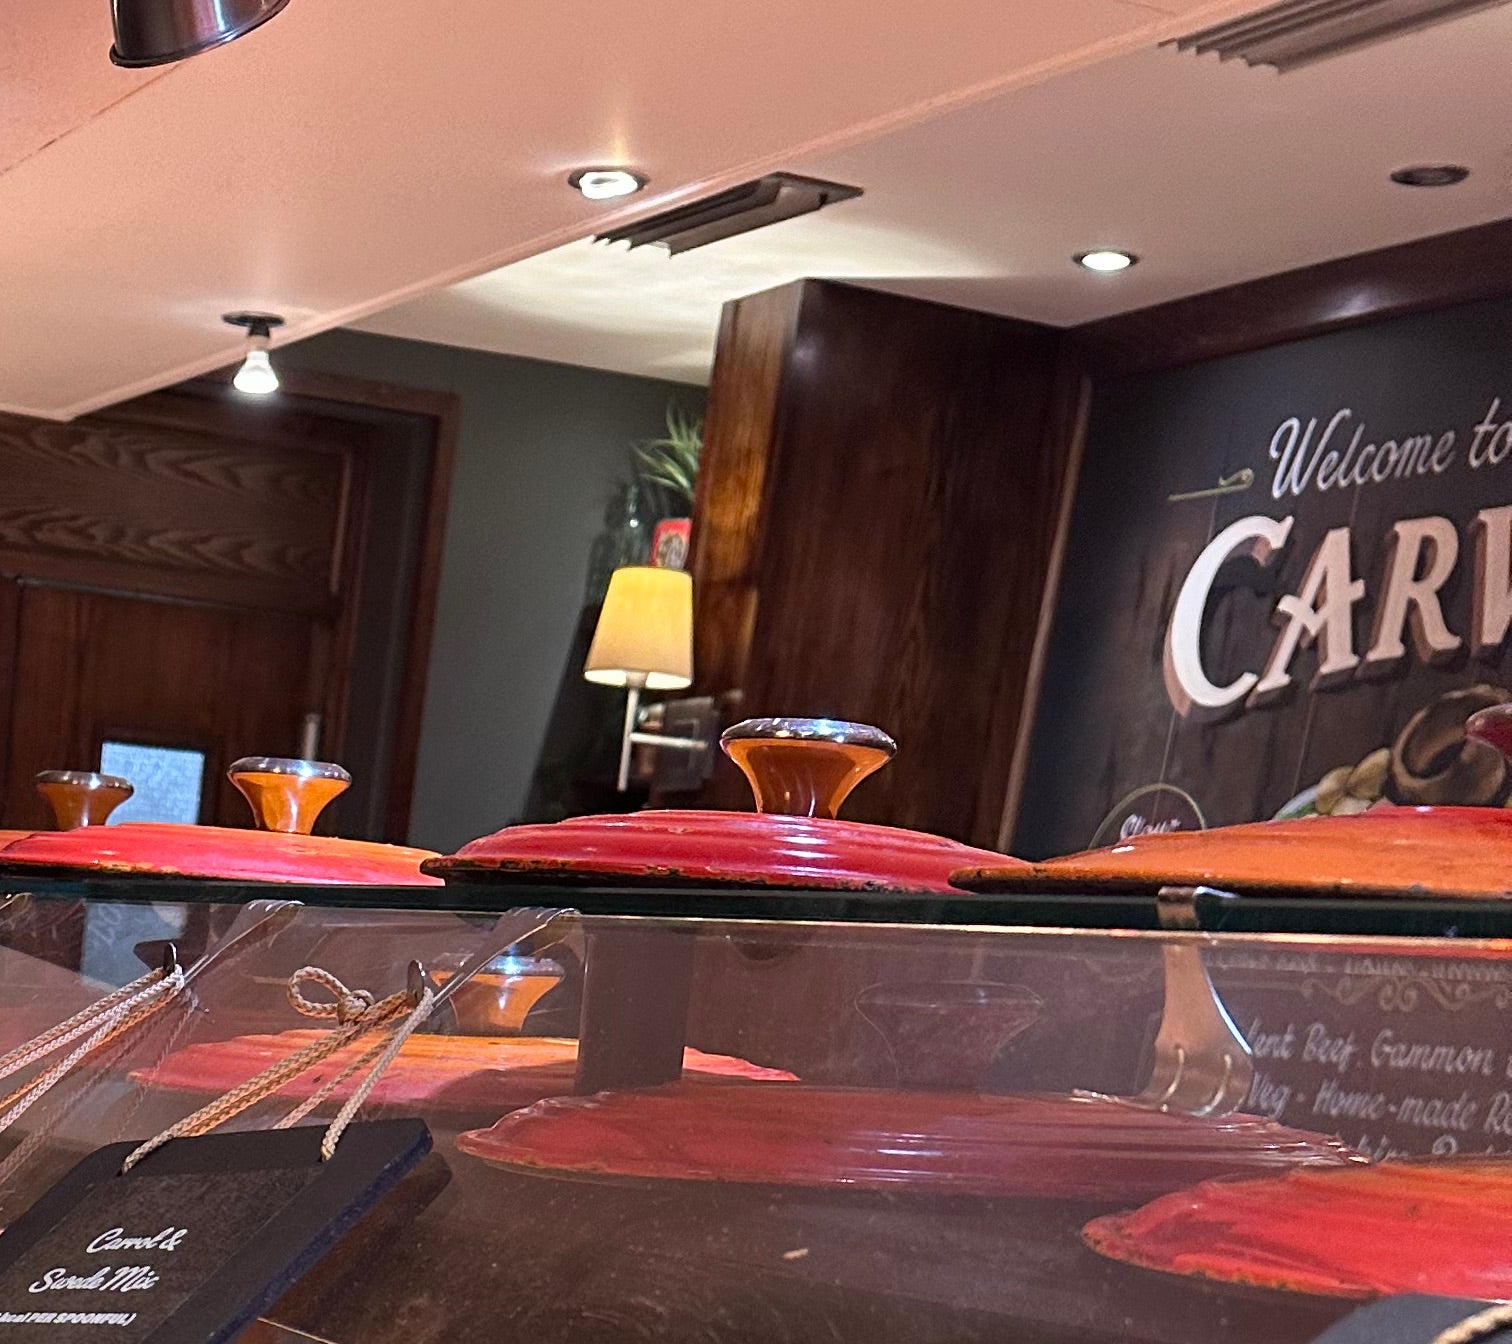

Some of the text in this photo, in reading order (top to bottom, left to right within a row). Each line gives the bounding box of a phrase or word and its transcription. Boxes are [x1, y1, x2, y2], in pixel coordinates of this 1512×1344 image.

[1269, 408, 1456, 499] Welcome
[1370, 1027, 1495, 1077] Gammon
[158, 1228, 188, 1251] &
[99, 1266, 160, 1292] Mix
